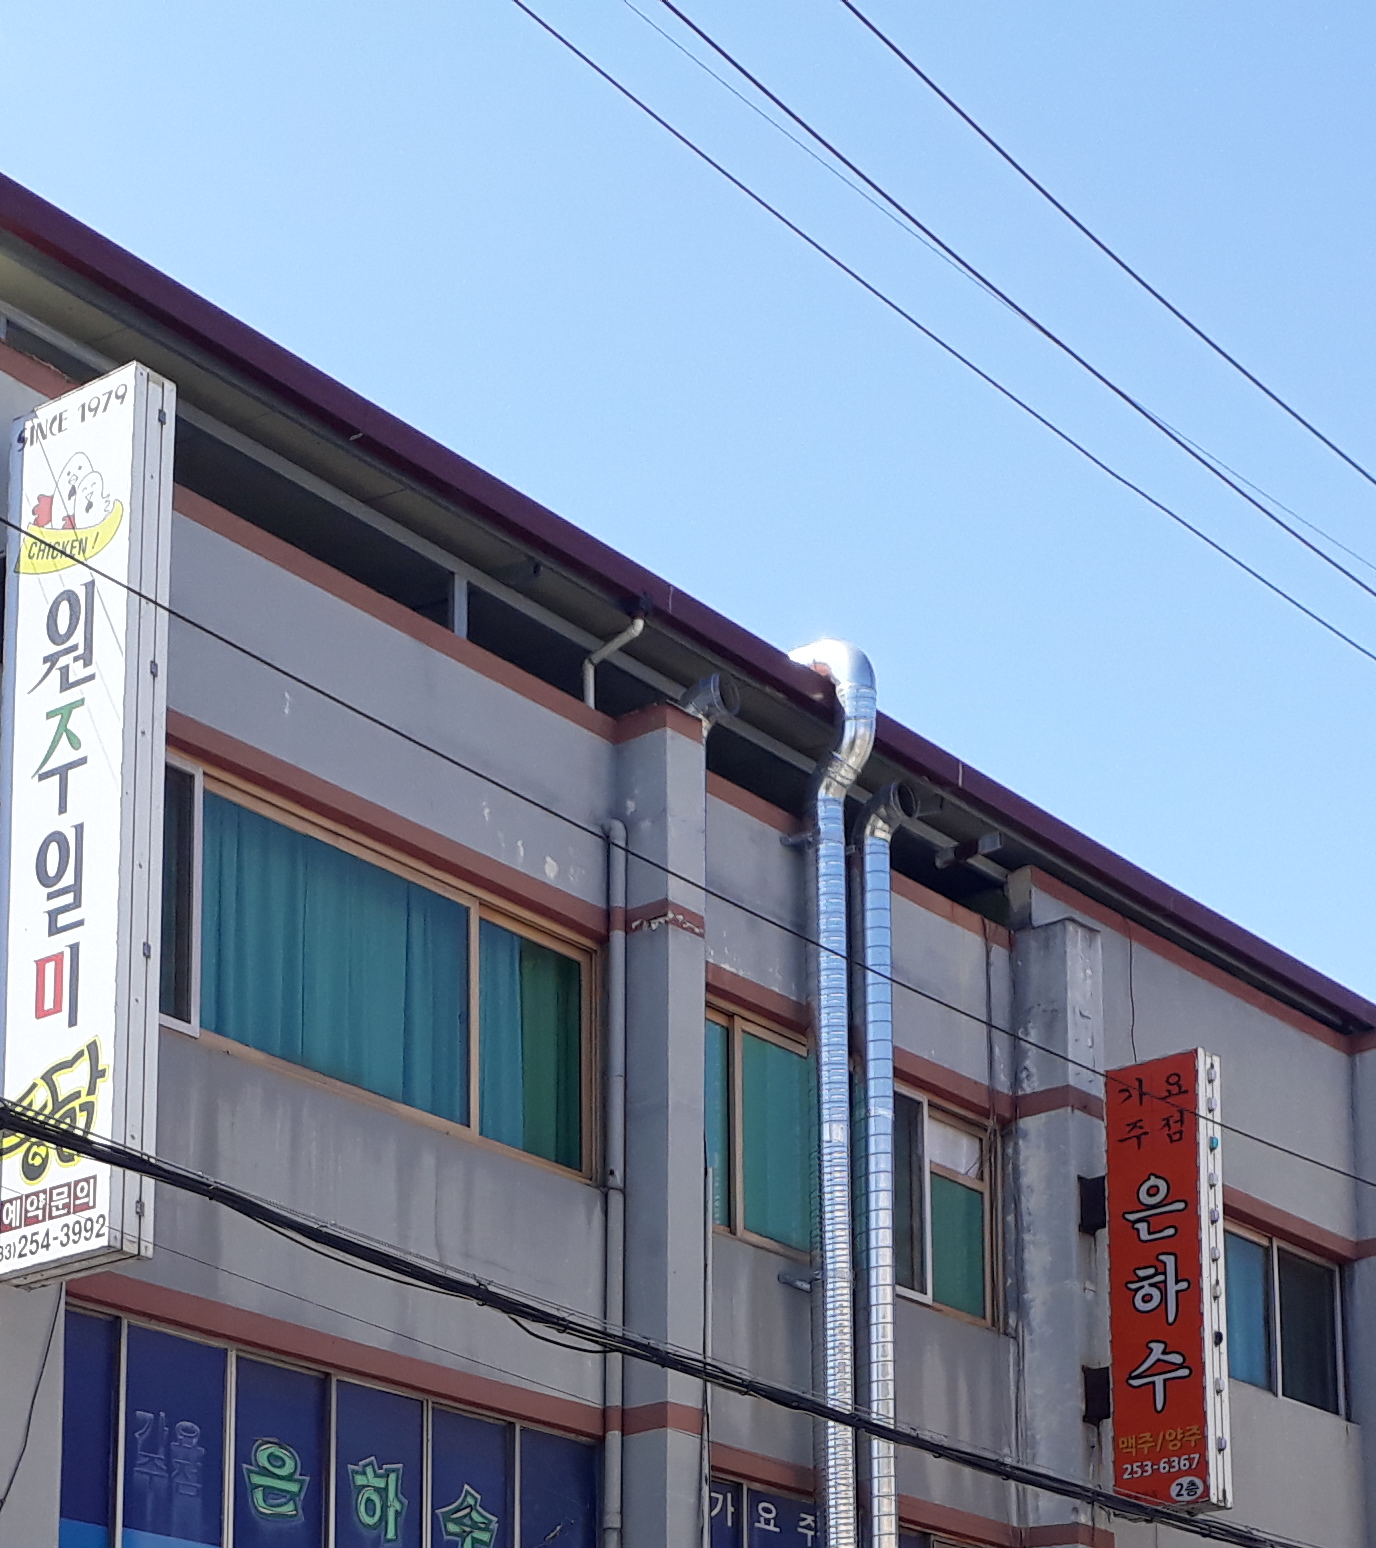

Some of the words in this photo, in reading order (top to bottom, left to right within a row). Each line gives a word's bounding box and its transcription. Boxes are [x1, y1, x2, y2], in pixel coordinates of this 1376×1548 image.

[17, 409, 68, 452] SINCE
[78, 383, 128, 423] 1979
[2, 1175, 96, 1233] 예약문의
[1122, 1173, 1192, 1414] 은하수
[1118, 1424, 1204, 1455] 맥주/양주
[1123, 1453, 1201, 1480] 253-6367
[1175, 1479, 1200, 1498] 2층
